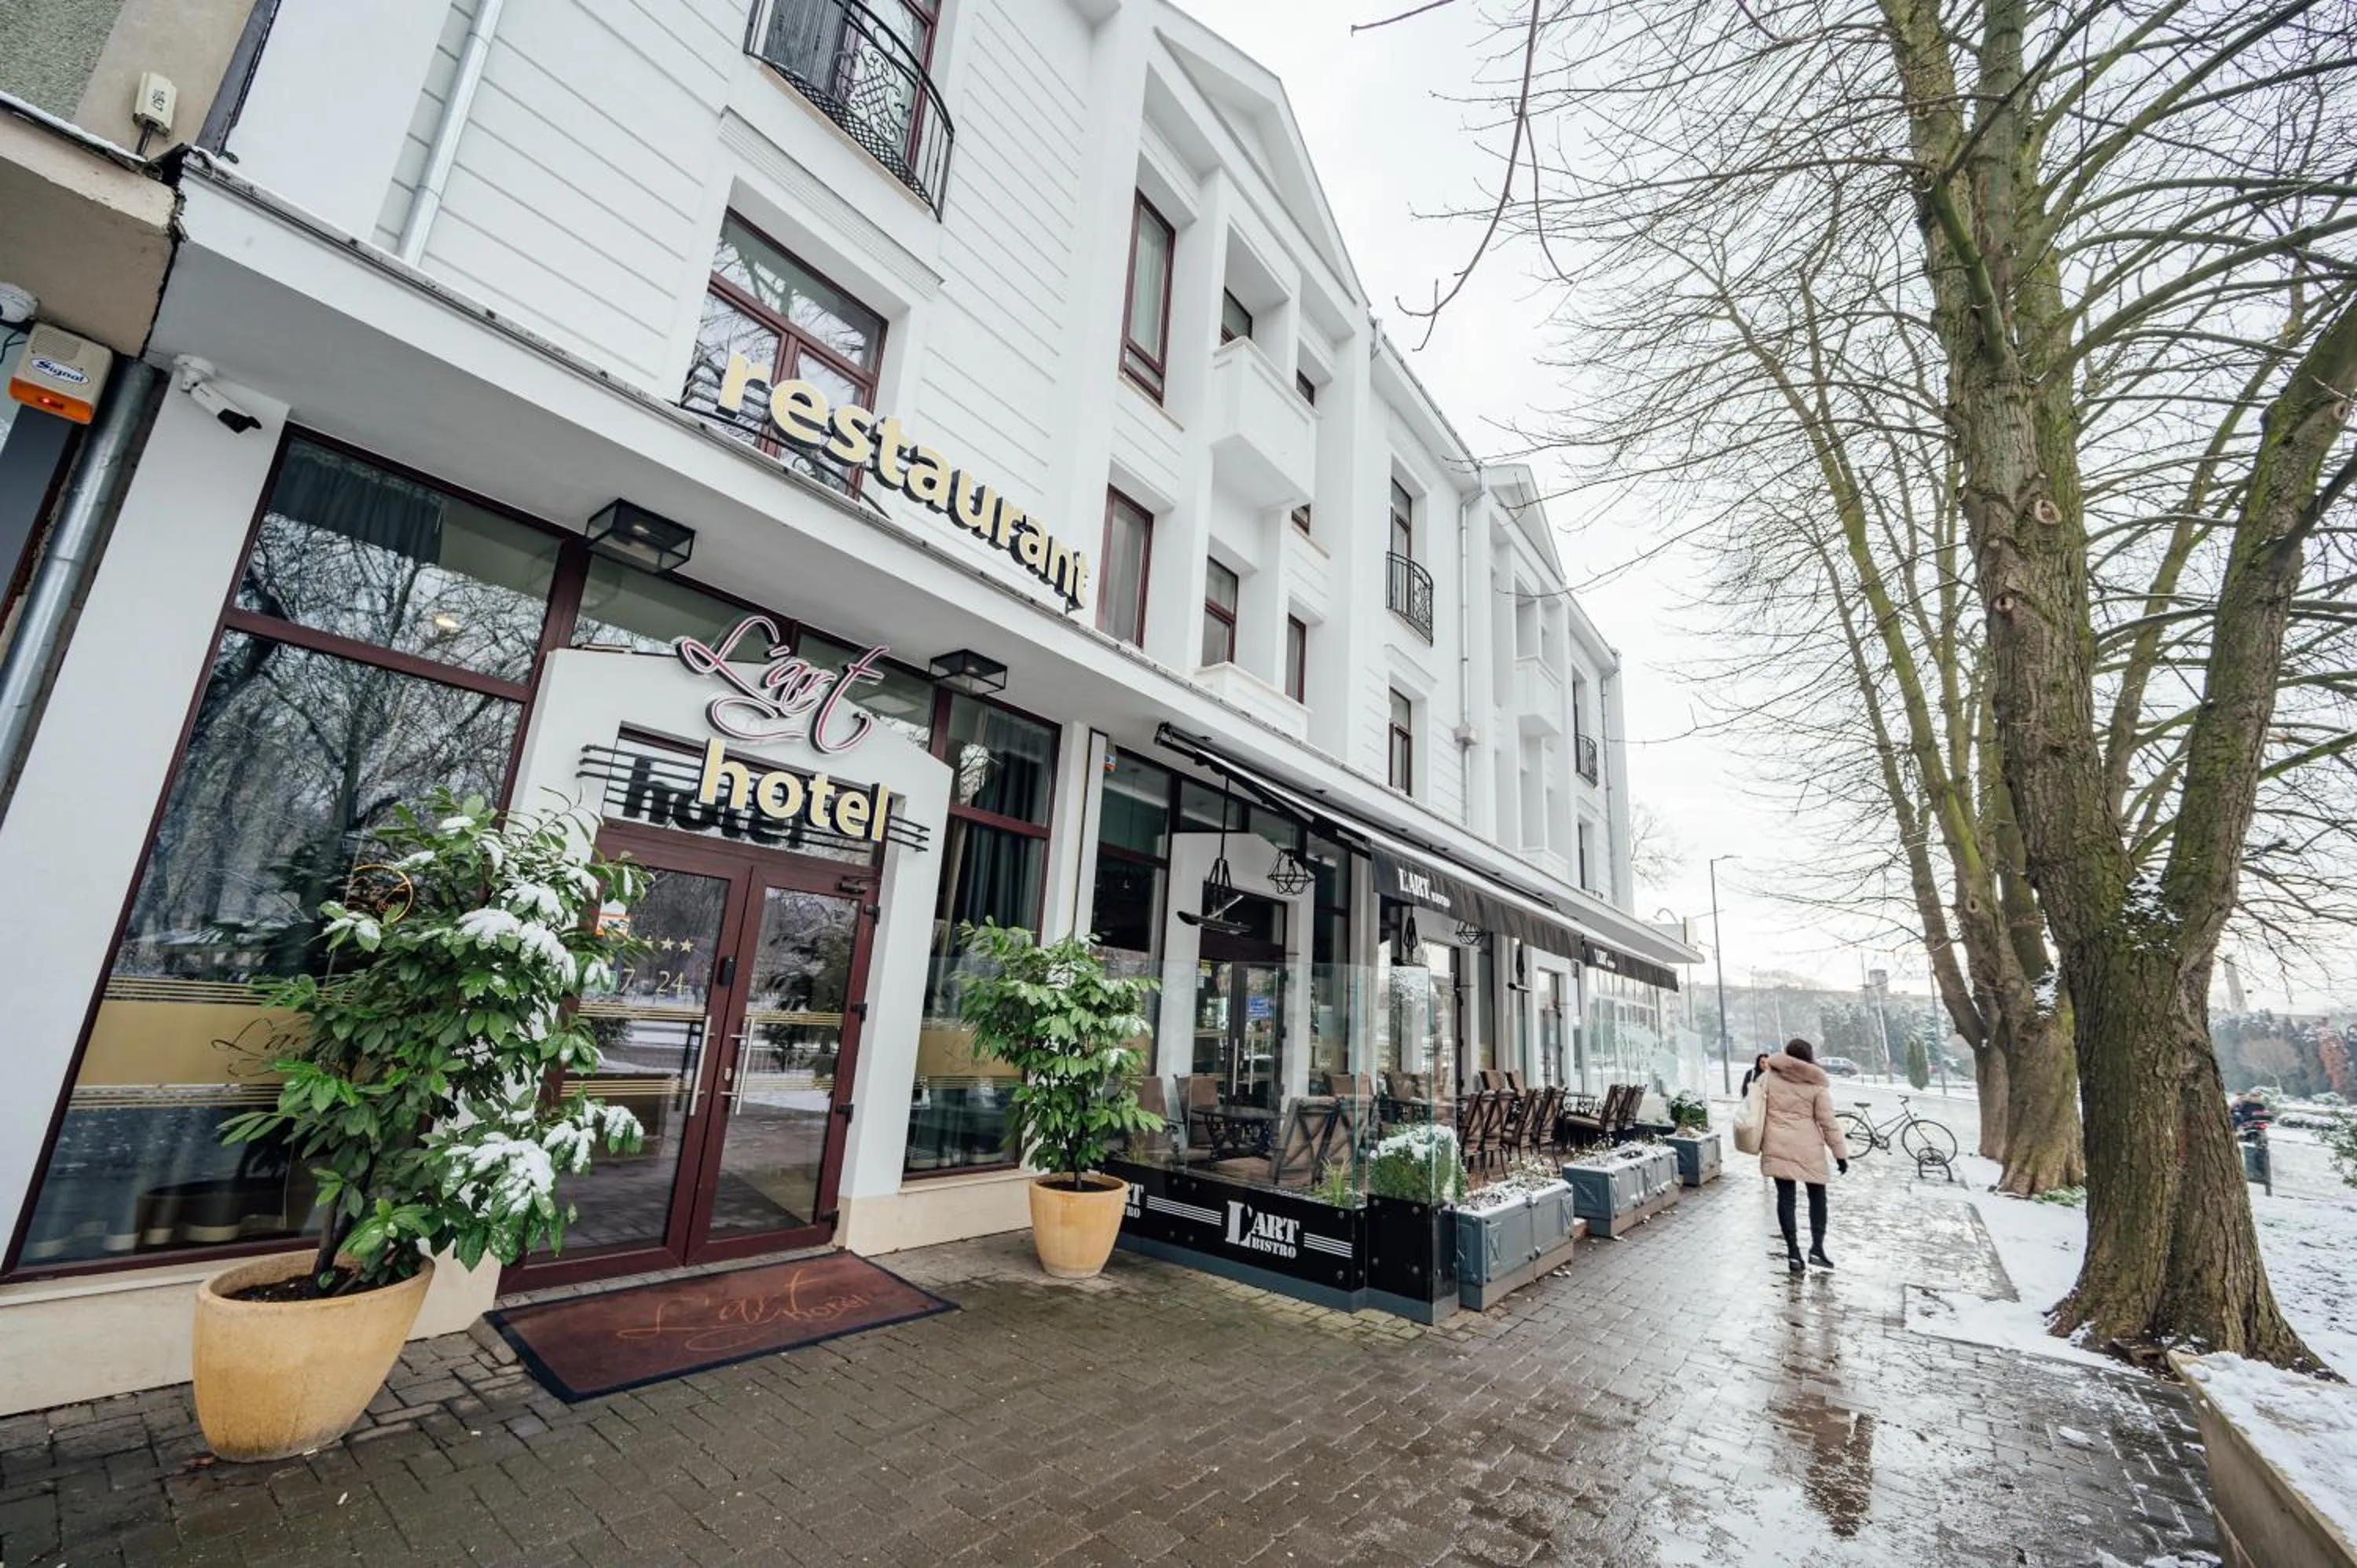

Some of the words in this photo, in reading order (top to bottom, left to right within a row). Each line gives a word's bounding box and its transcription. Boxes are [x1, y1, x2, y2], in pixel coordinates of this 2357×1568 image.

[717, 351, 1089, 609] restaurant
[676, 615, 891, 755] L'art
[698, 737, 893, 842] hotel
[655, 969, 688, 995] 24
[1225, 1200, 1300, 1247] L'ART
[1250, 1236, 1298, 1258] BISTRO
